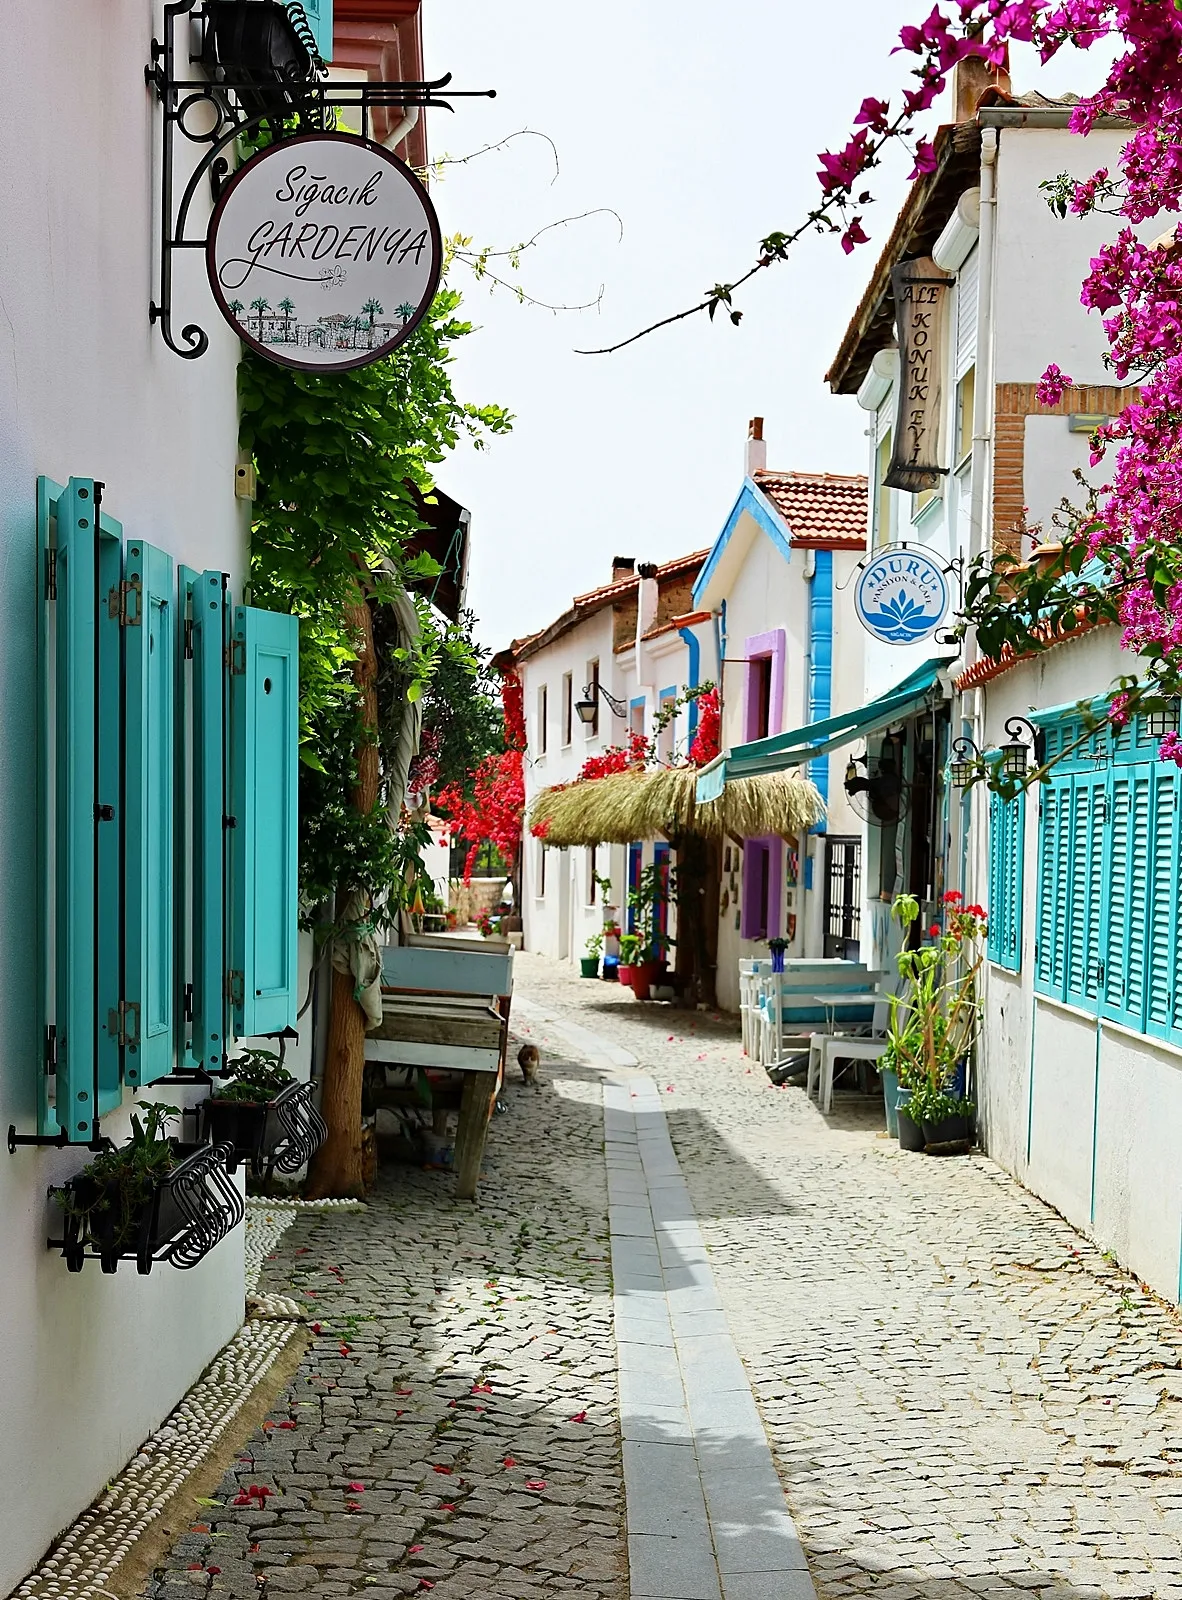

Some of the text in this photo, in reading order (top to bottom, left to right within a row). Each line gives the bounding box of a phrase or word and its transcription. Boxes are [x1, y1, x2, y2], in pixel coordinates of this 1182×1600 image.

[275, 165, 383, 217] Sığacık
[246, 220, 429, 267] GARDENYA
[908, 313, 932, 401] KONUK
[870, 559, 937, 584] DURU
